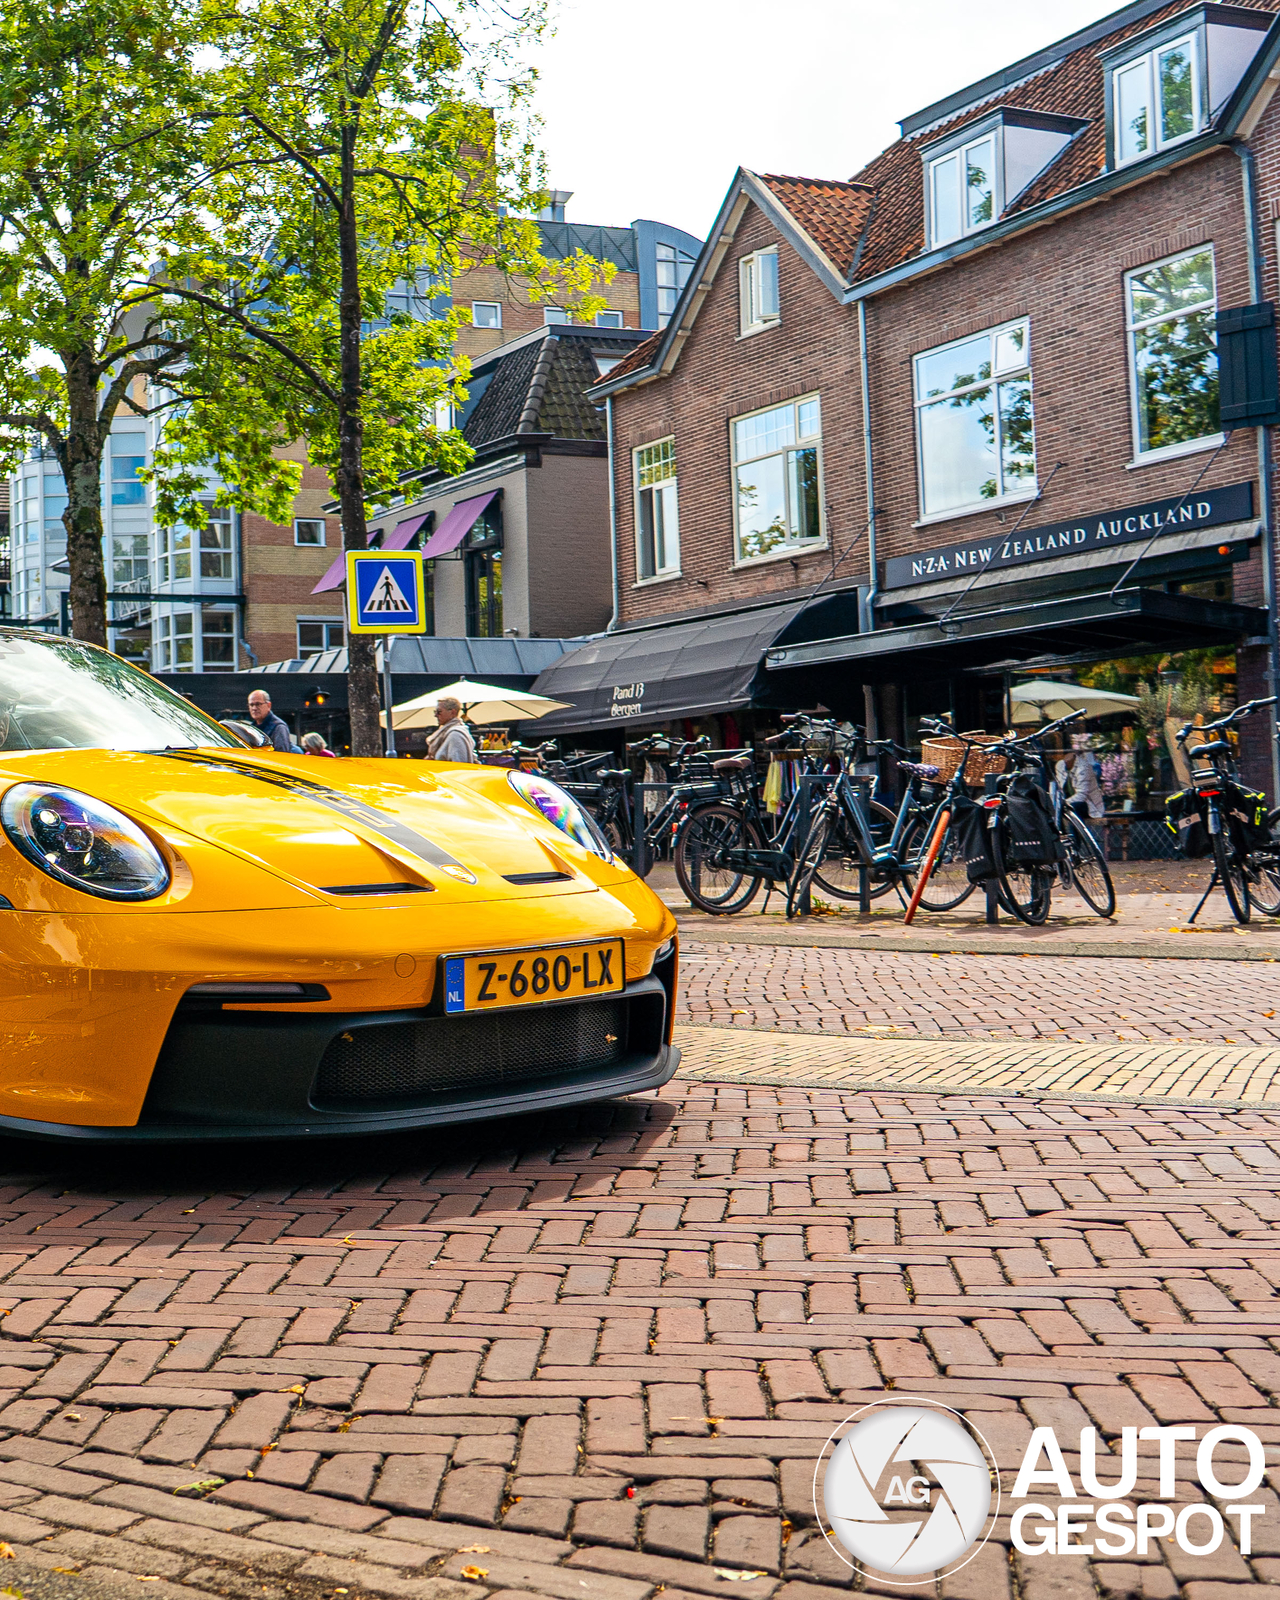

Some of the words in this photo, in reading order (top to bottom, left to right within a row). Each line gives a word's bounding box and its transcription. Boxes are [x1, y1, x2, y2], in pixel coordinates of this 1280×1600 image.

[954, 547, 993, 568] NEW
[1000, 527, 1087, 559] ZEALAND
[1095, 501, 1212, 540] AUCKLAND
[612, 683, 635, 700] Pand
[610, 702, 642, 717] Bergen
[477, 948, 614, 1001] Z-680-LX
[448, 990, 462, 1003] NL
